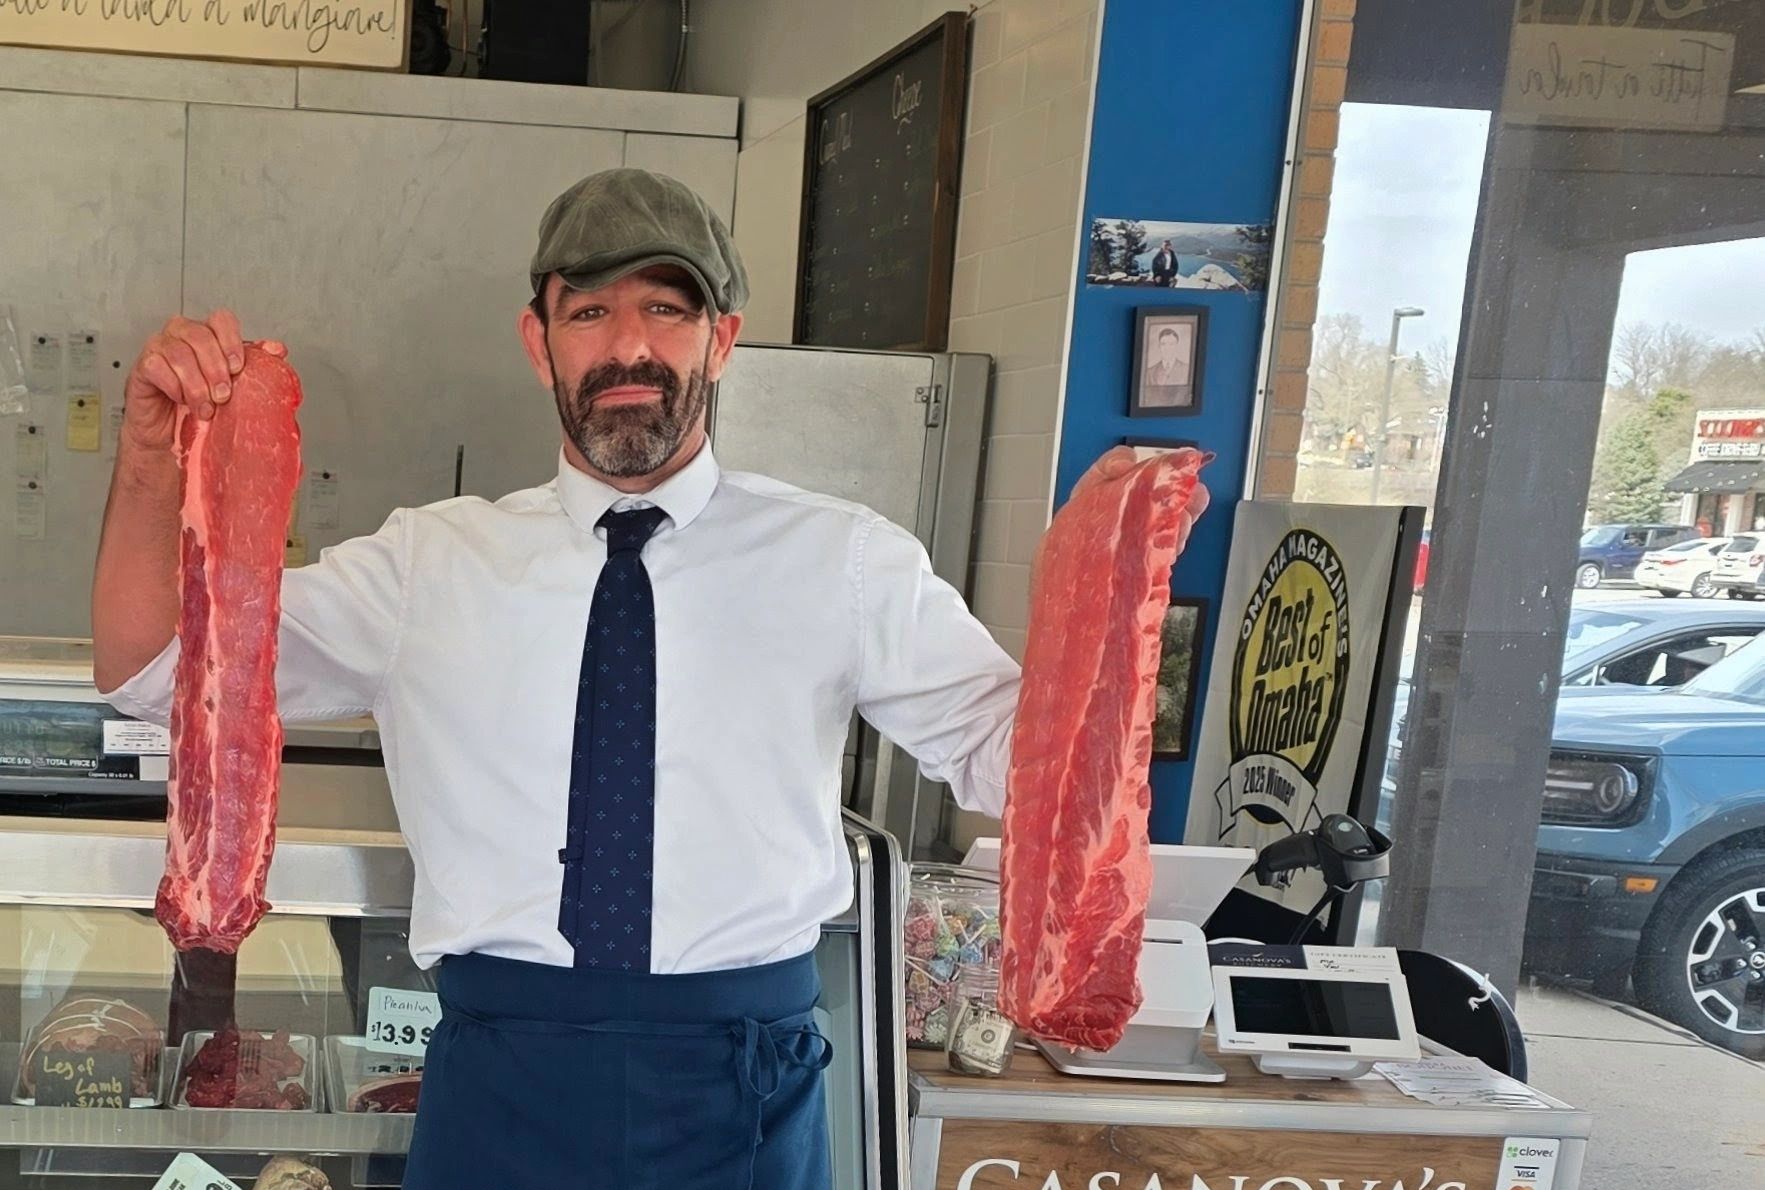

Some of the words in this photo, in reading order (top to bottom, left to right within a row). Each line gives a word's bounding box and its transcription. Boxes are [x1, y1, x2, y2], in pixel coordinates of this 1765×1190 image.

[1242, 547, 1288, 640] OMAHA
[1288, 534, 1348, 658] MAGAZINE'S
[1255, 588, 1315, 677] Best
[1308, 611, 1333, 665] of
[1245, 666, 1325, 752] Omaha
[46, 758, 68, 767] TOTAL
[69, 760, 91, 768] PRICE
[1243, 766, 1266, 795] 2025
[1265, 766, 1297, 808] Winner
[43, 1055, 74, 1080] Leg
[77, 1057, 95, 1076] of
[75, 1076, 122, 1096] Lamb
[1519, 1146, 1554, 1158] clover
[1516, 1169, 1536, 1178] VISA
